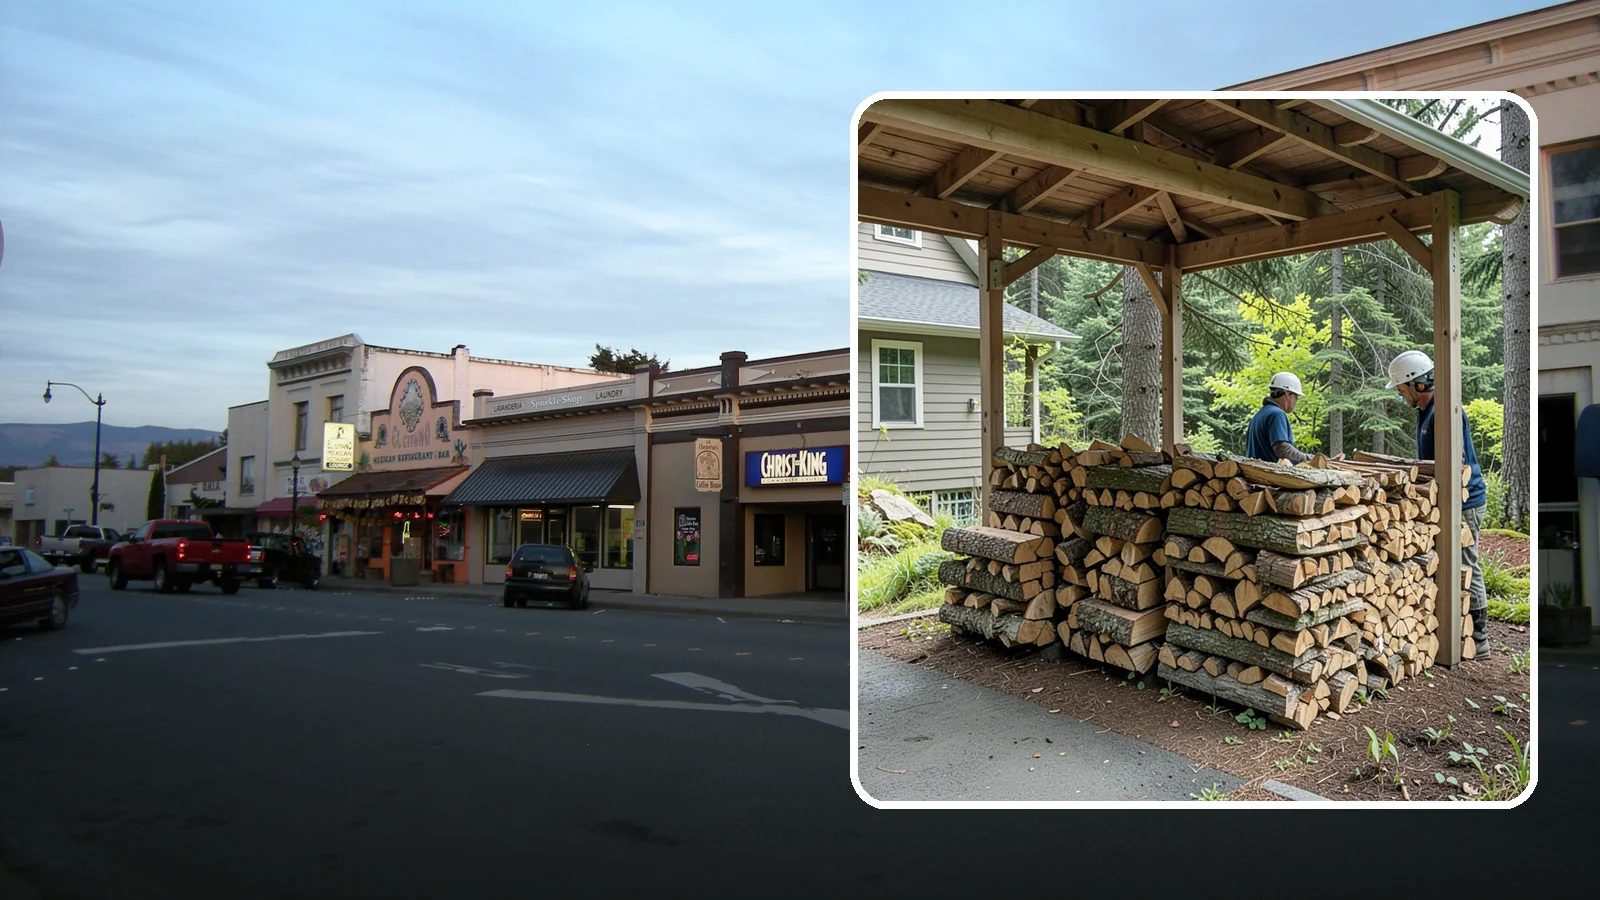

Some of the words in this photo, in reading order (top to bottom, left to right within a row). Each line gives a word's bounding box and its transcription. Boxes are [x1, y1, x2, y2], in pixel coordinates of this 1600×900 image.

[493, 401, 523, 412] LAVANDERIA
[562, 394, 583, 406] Shop
[595, 388, 624, 400] LAUNDRY
[397, 451, 433, 462] RESTAURANT
[437, 449, 450, 459] BAR
[760, 452, 797, 478] CHRIST
[799, 449, 827, 477] KING
